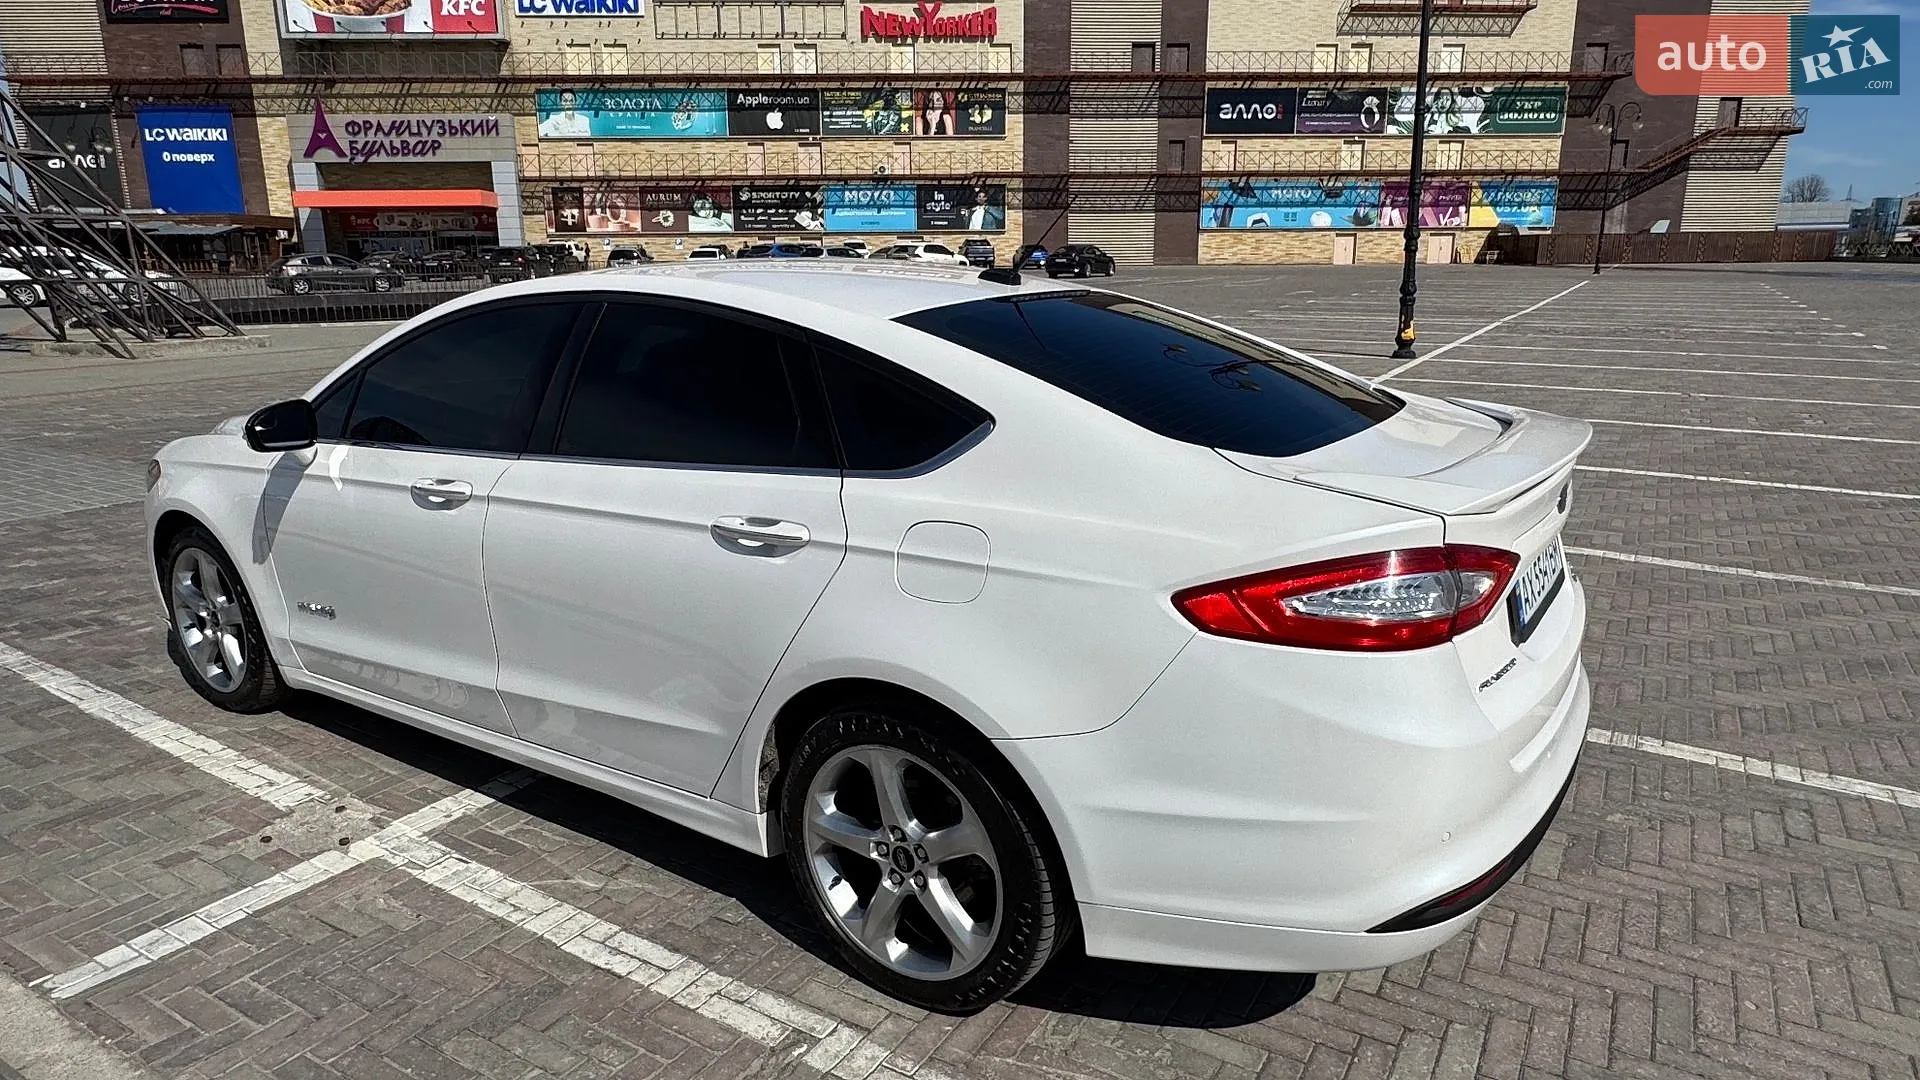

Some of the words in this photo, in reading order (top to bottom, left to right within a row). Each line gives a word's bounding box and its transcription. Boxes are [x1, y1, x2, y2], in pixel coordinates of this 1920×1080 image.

[440, 0, 486, 16] KFC
[737, 93, 810, 107] Appleroom.ua
[344, 115, 500, 138] ФРАНЦУЗЬКИЙ
[172, 153, 215, 164] поверх
[646, 193, 682, 201] AURUM
